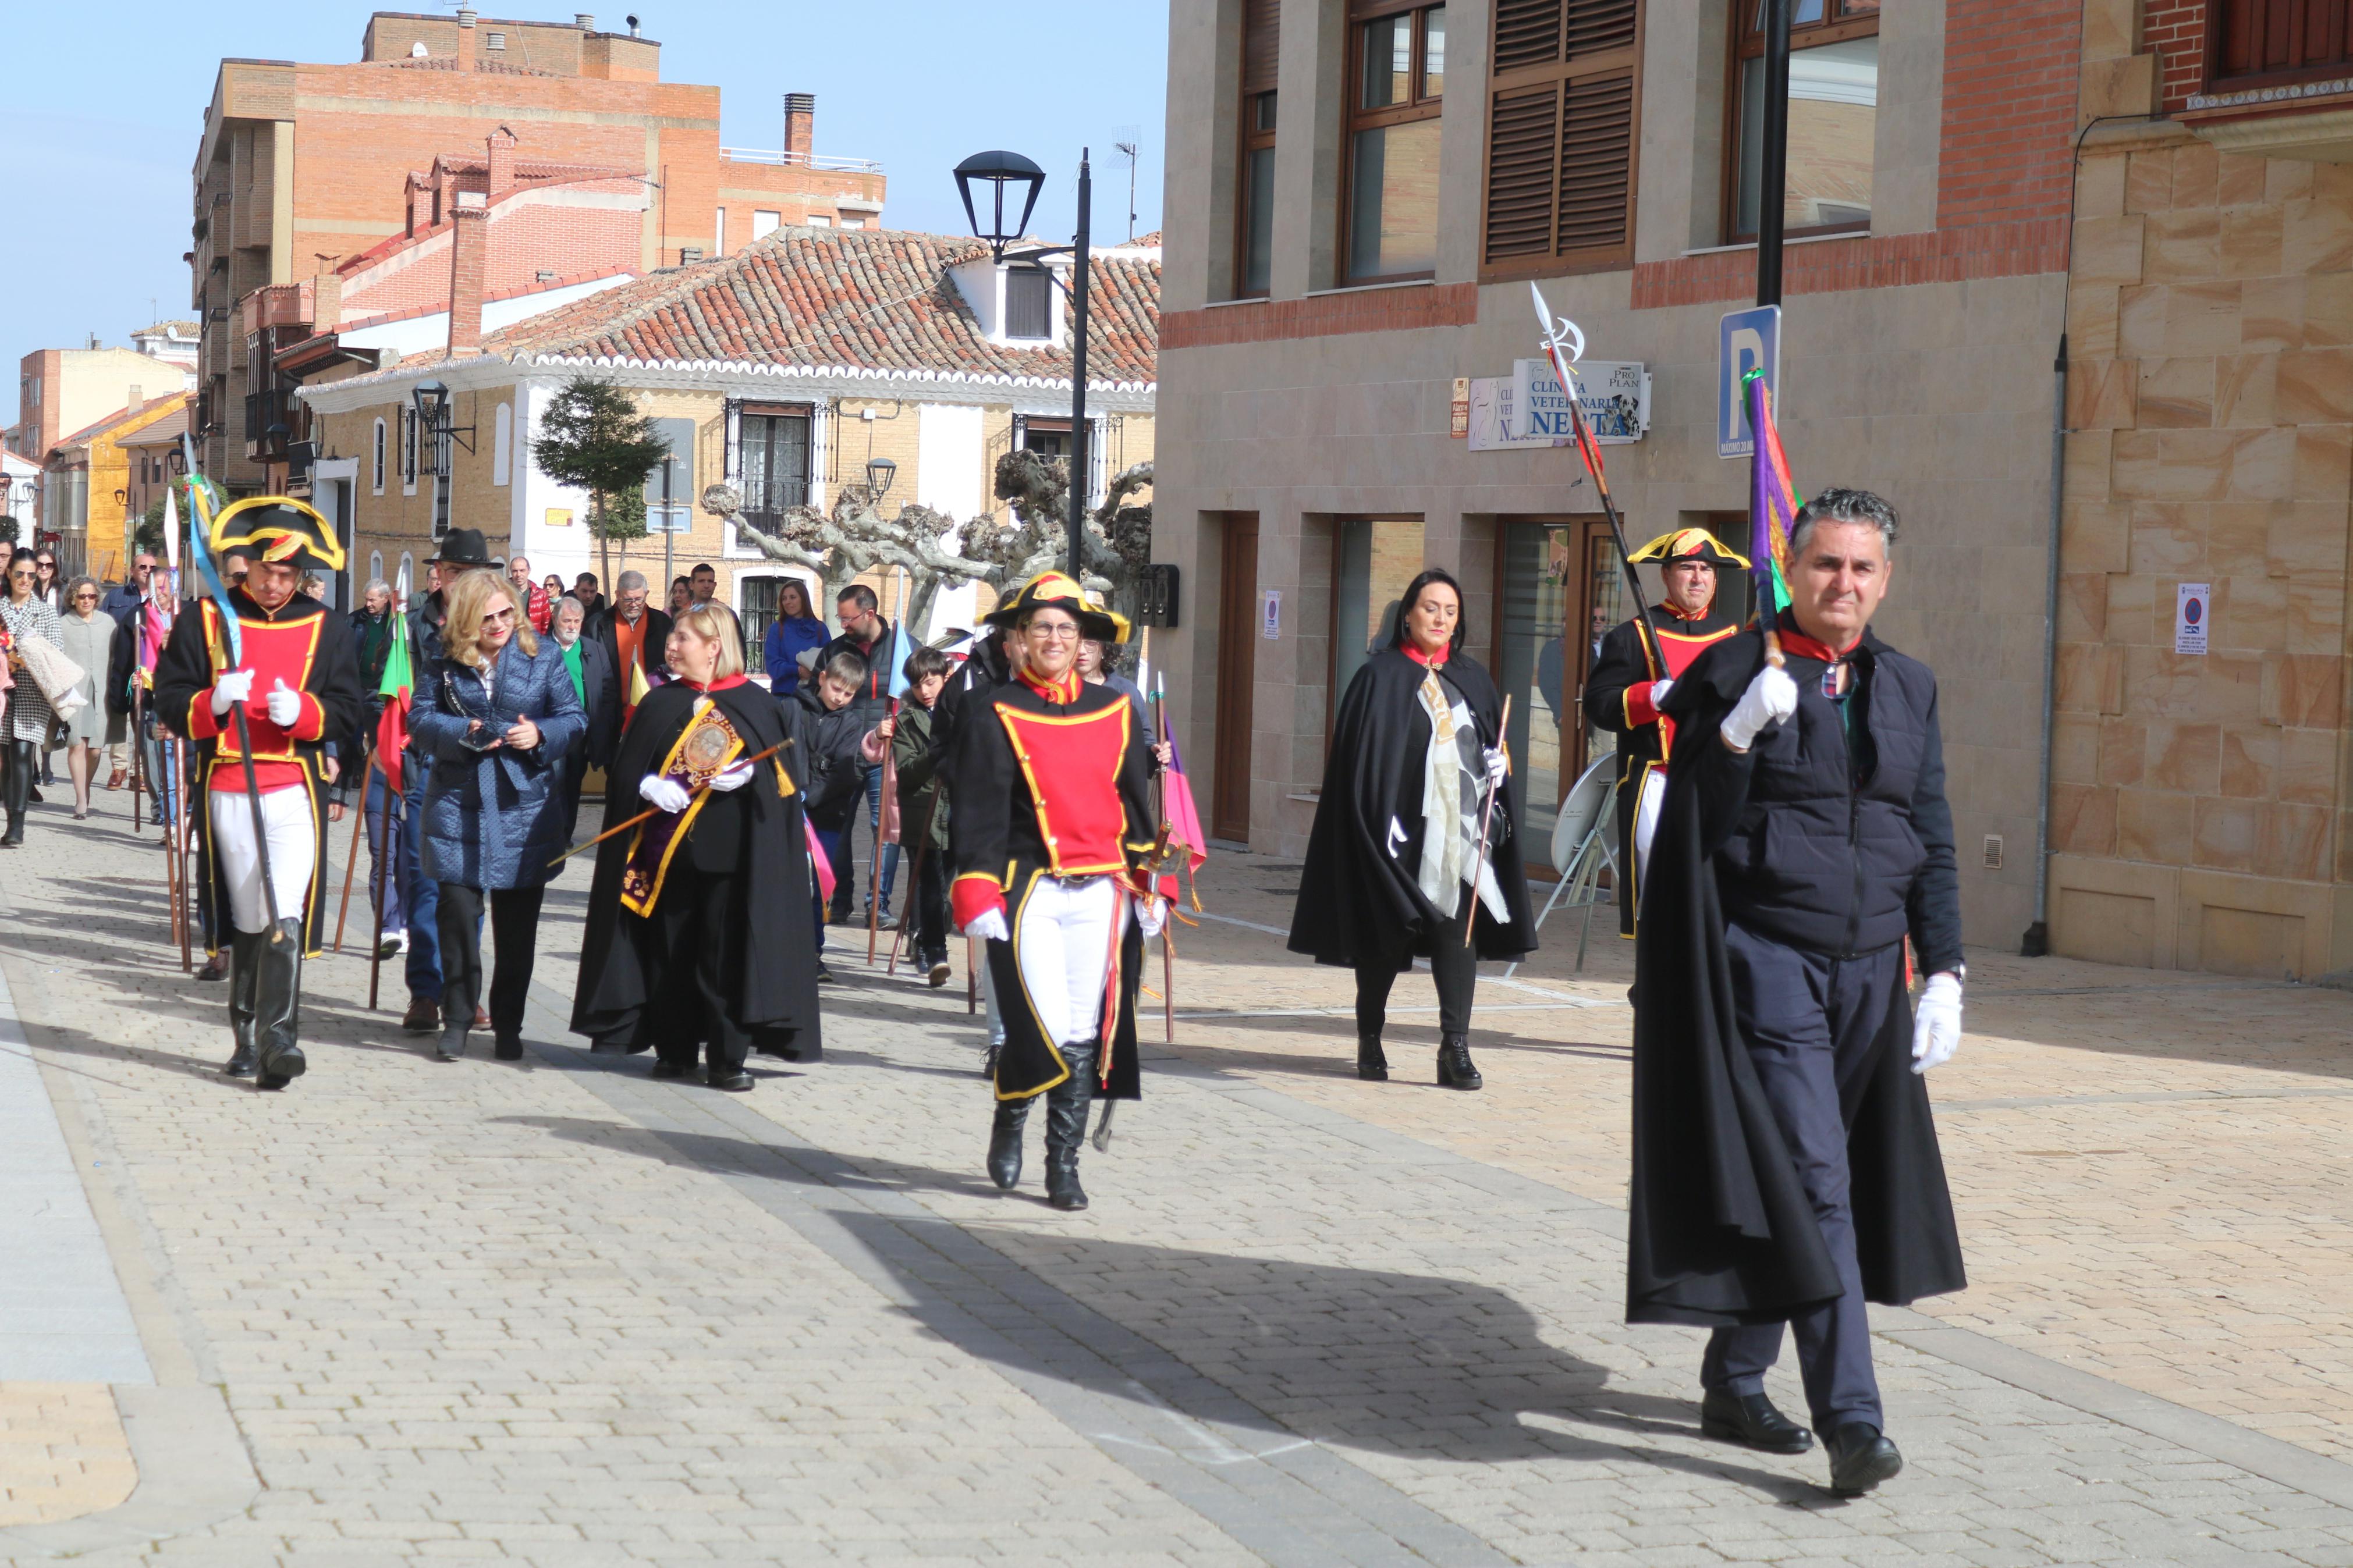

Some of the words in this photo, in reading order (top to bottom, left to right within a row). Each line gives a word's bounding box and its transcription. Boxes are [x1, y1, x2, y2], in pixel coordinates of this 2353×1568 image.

[1614, 370, 1635, 379] PRO
[1531, 378, 1587, 393] CLÍNA
[1609, 378, 1639, 387] PLAN
[1729, 328, 1763, 440] P
[1531, 396, 1620, 409] VETENARIA
[1529, 411, 1629, 436] NETA
[1721, 440, 1740, 454] MÁXIMO
[1741, 441, 1747, 452] 20
